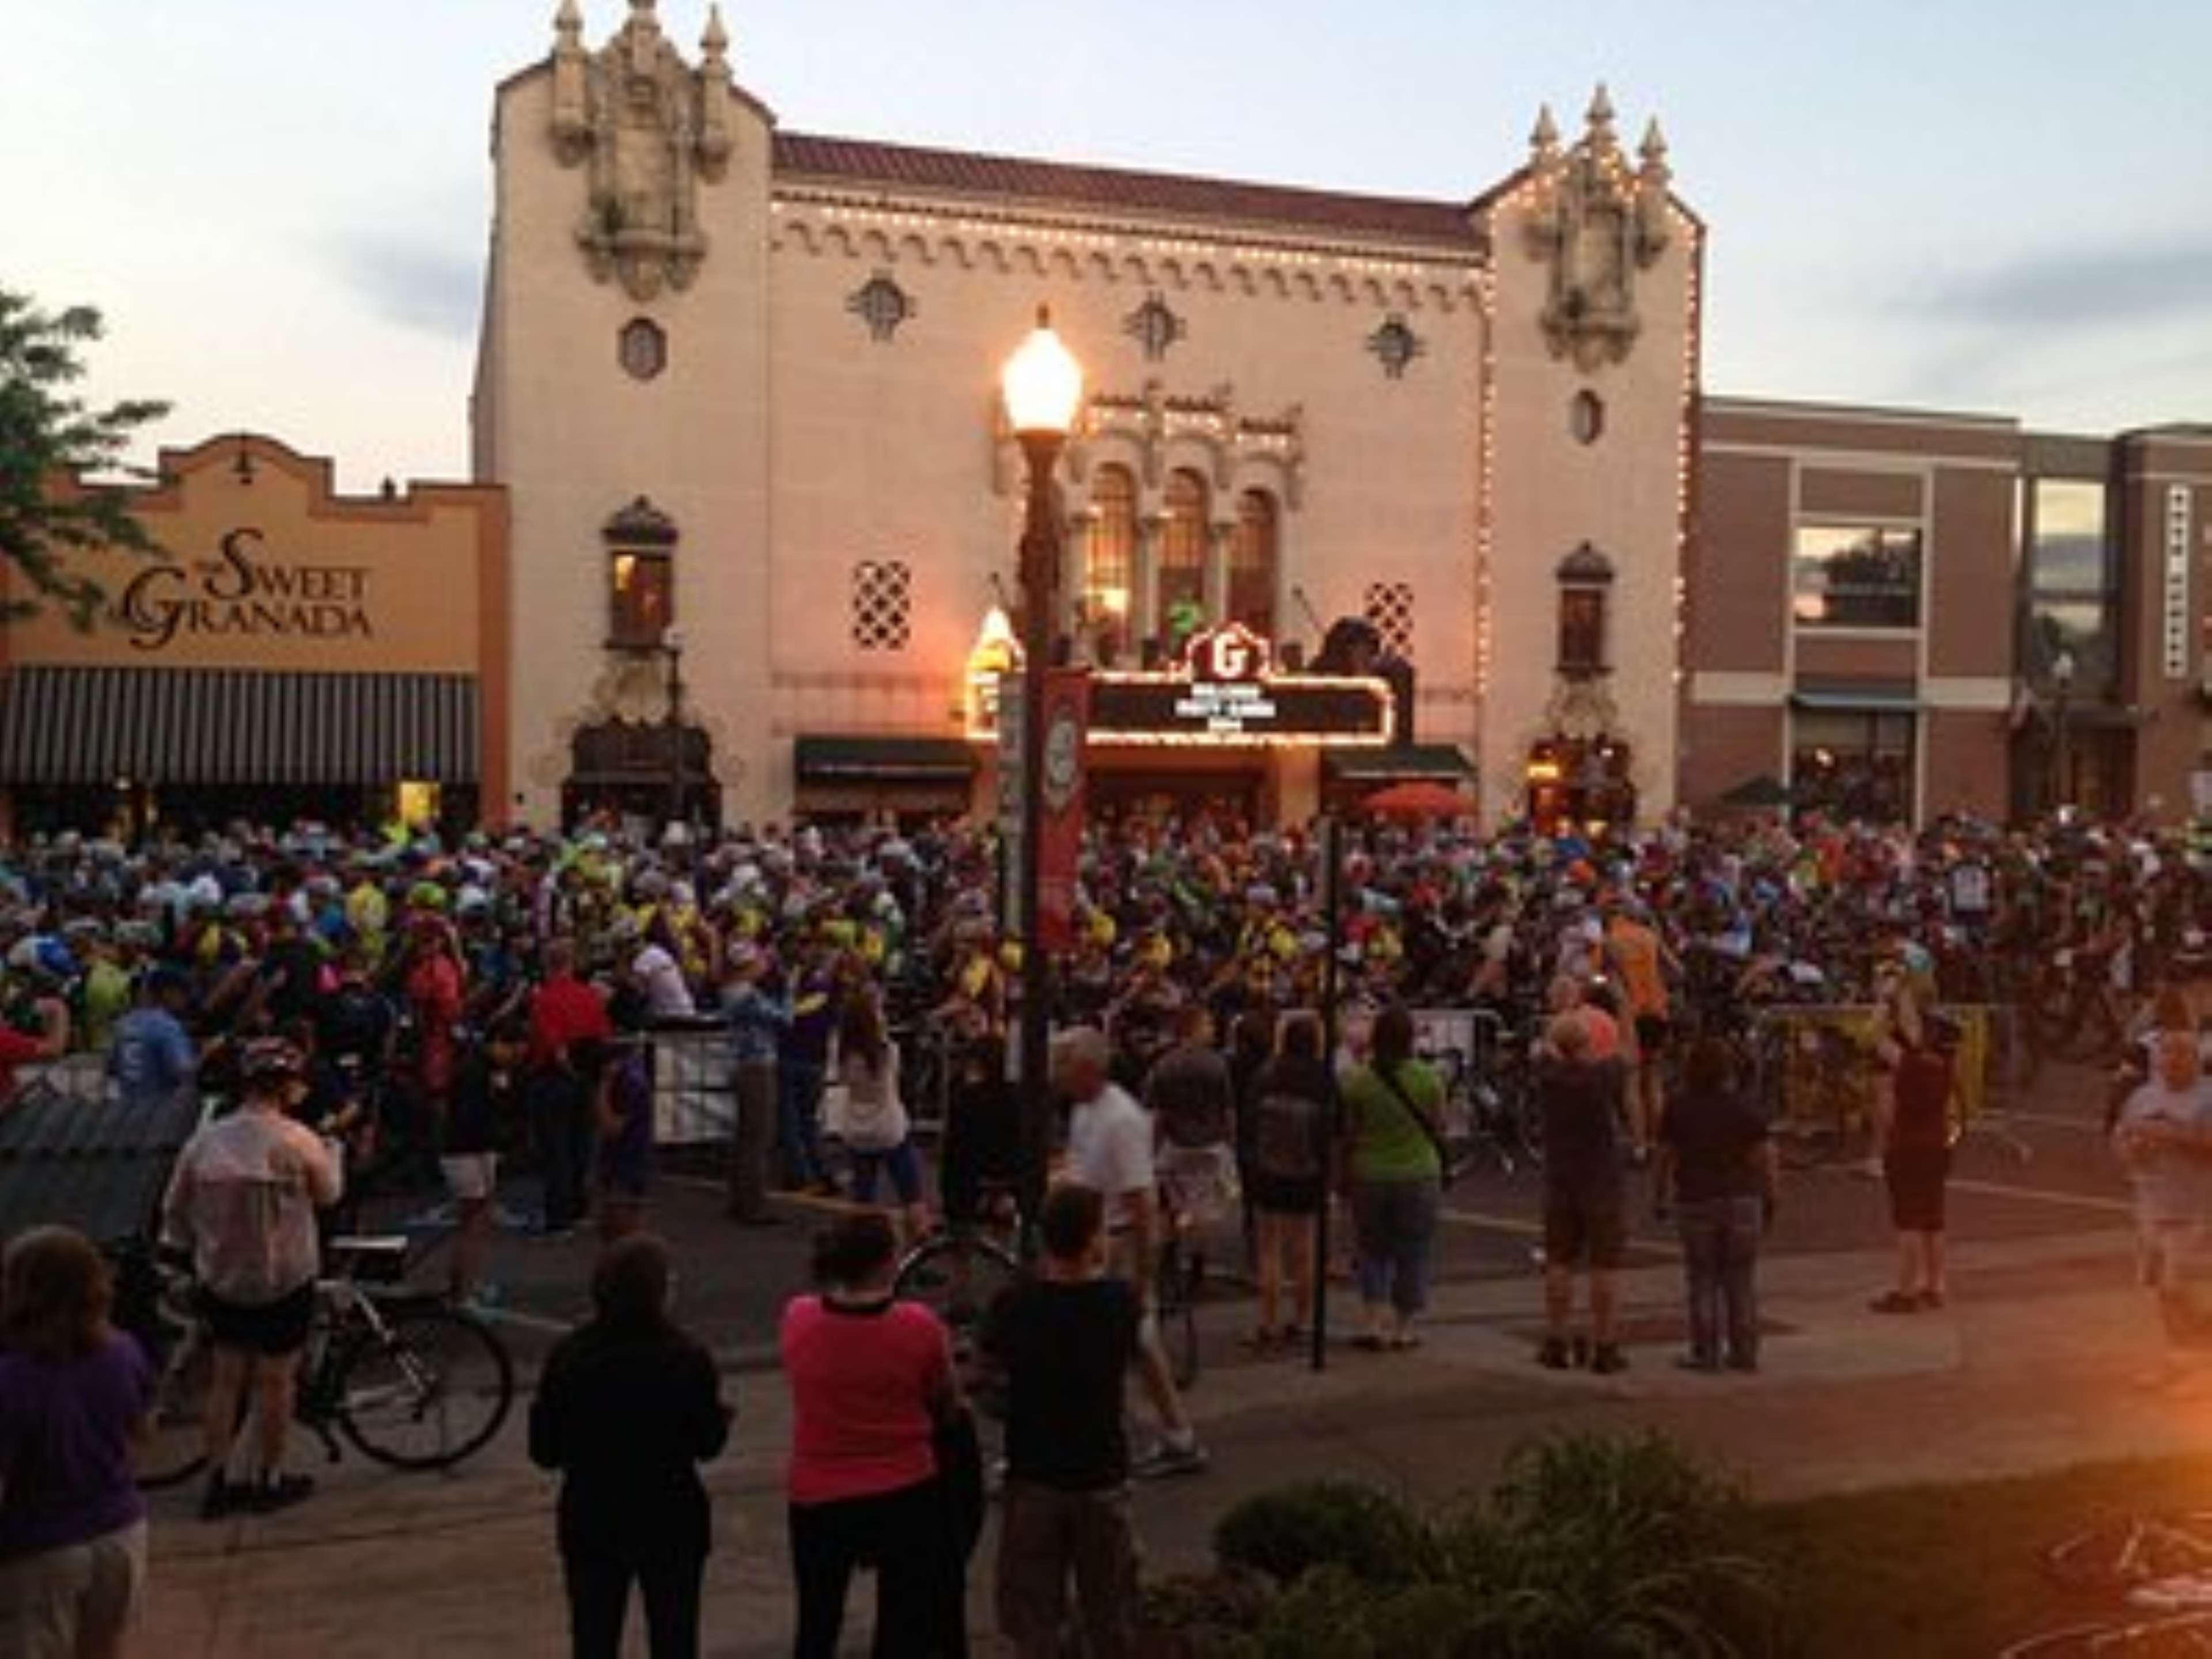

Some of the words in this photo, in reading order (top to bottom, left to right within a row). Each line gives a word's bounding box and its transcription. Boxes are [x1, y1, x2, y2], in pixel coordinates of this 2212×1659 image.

[202, 527, 372, 600] SWEET
[122, 566, 373, 649] GRANADA
[1213, 631, 1248, 679] G
